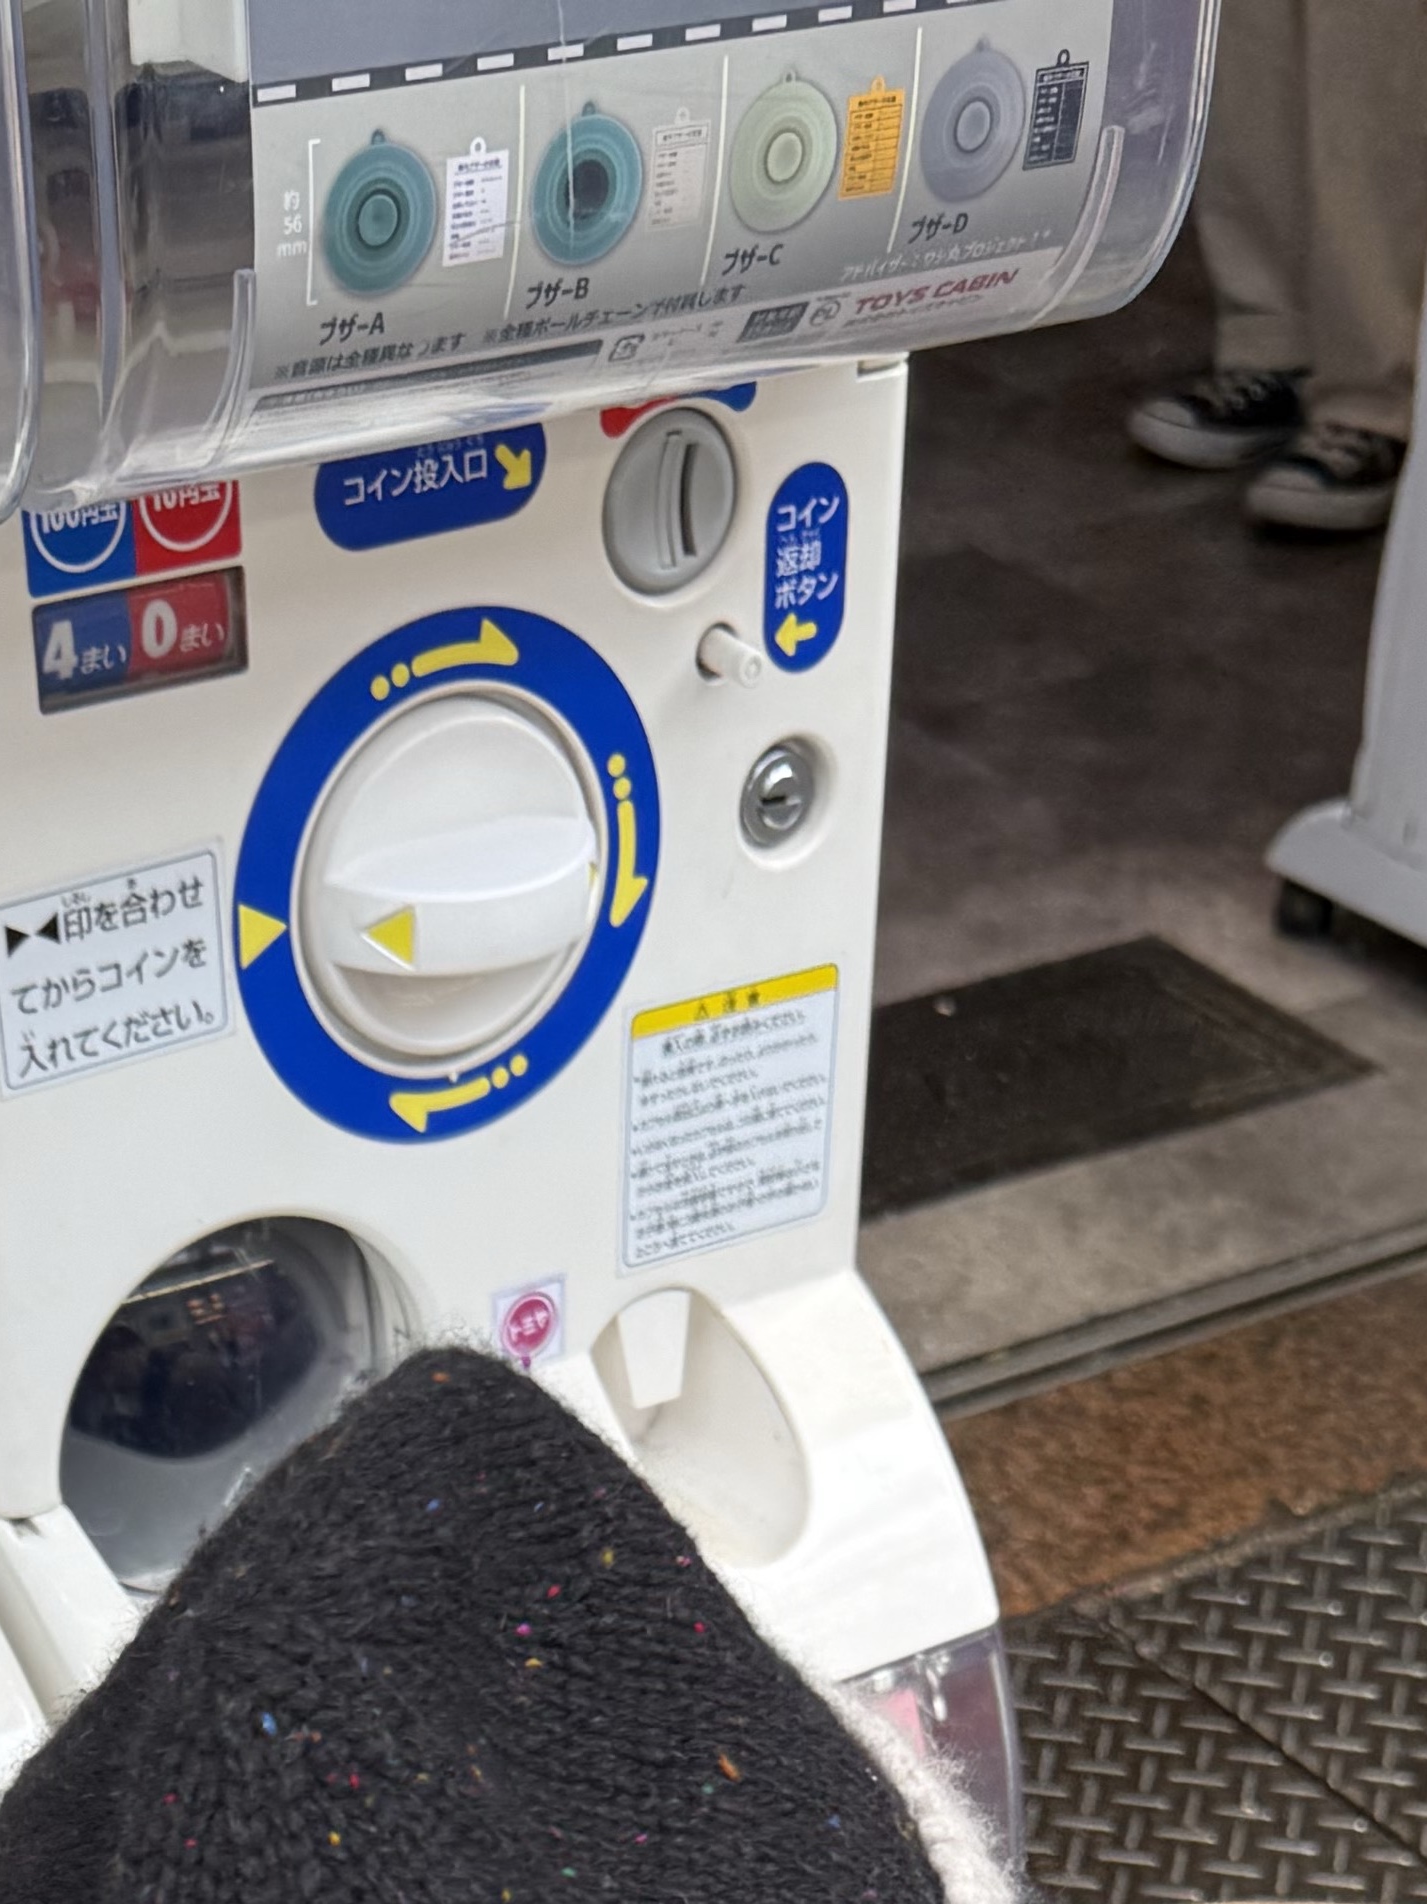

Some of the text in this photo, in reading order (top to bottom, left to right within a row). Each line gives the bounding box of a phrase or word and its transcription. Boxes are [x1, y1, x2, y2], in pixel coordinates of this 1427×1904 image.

[282, 214, 303, 235] 56
[855, 284, 931, 315] TOYS
[932, 268, 1020, 300] CABIN
[343, 447, 488, 506] コイン投入口
[776, 496, 840, 532] コイン
[774, 572, 839, 609] ボタン
[10, 938, 208, 1015] てからコインを
[20, 1000, 215, 1079] 入れてください。
